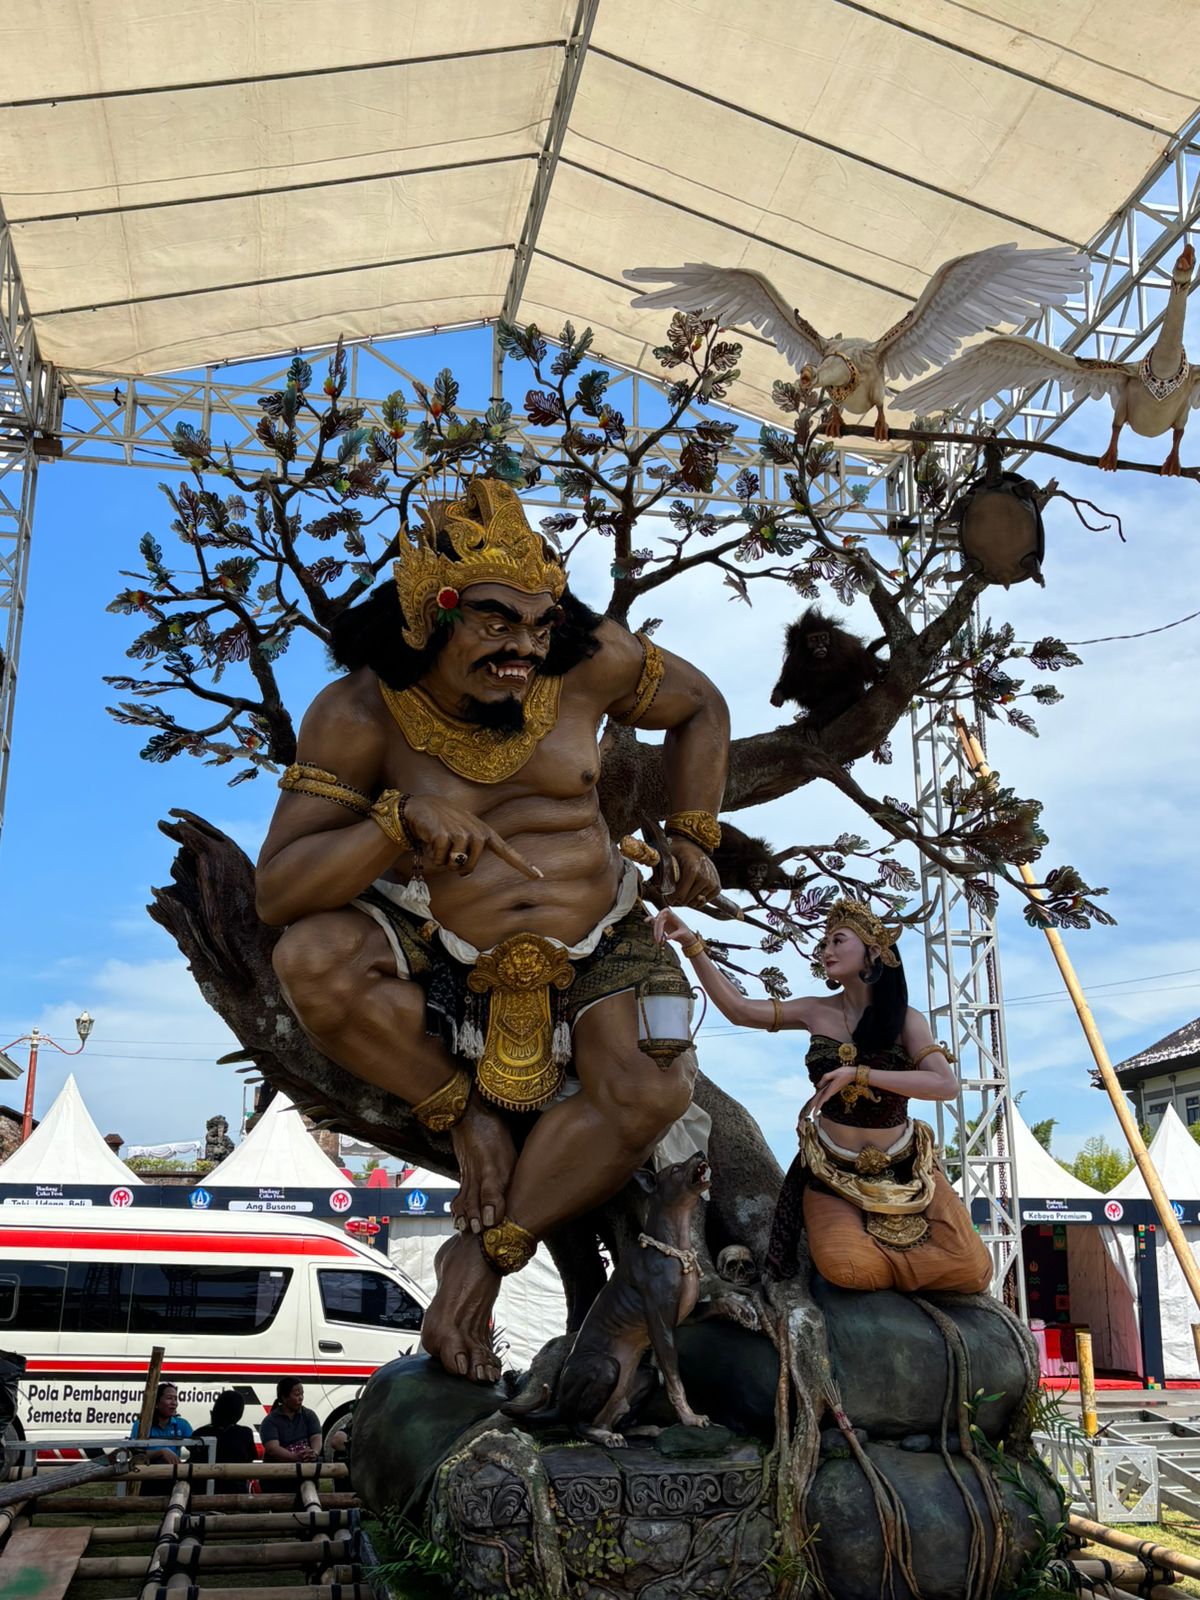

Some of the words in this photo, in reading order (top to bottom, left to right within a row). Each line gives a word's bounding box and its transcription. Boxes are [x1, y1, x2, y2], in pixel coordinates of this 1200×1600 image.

[246, 1202, 263, 1212] Ang
[266, 1202, 296, 1210] Busana
[1028, 1212, 1054, 1220] Kebaya
[28, 1384, 59, 1401] Pola
[63, 1386, 145, 1404] Pembangun
[175, 1385, 225, 1403] asiona
[27, 1406, 82, 1424] Semesta
[86, 1407, 142, 1424] Berenca
